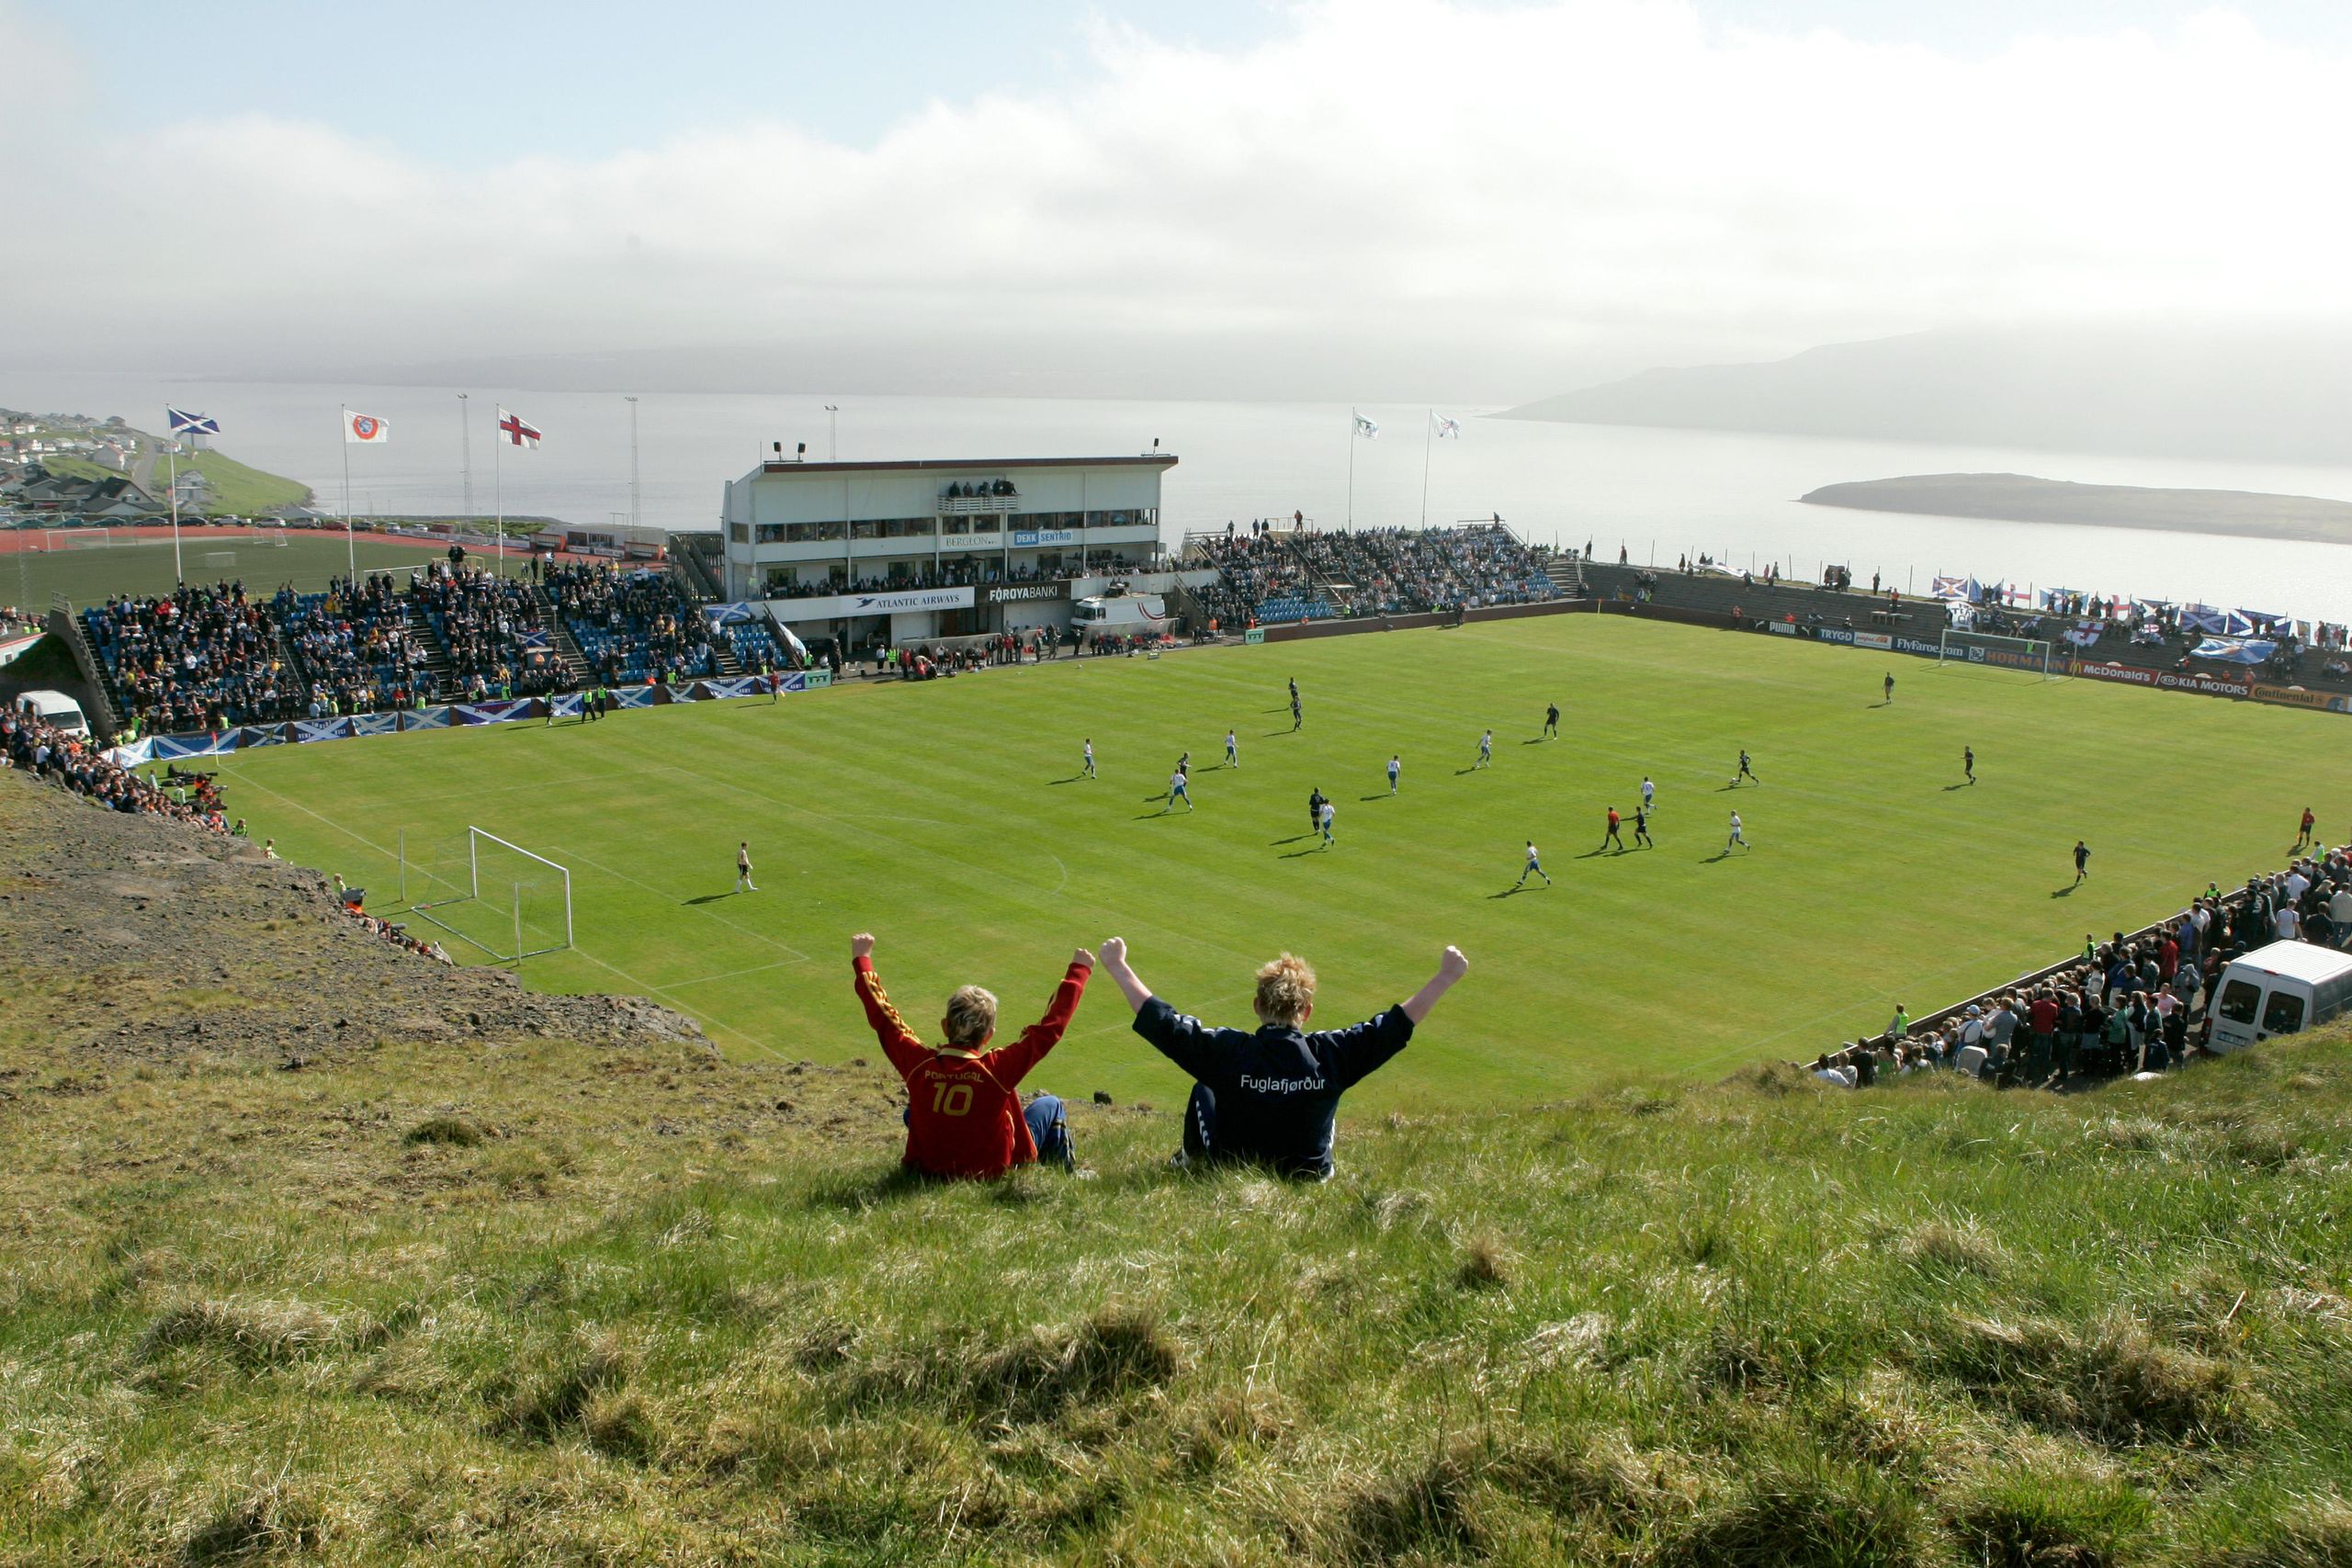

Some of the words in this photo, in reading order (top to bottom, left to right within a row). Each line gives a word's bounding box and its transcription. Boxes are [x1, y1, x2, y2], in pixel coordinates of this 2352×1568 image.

[1016, 535, 1037, 544] DEKK
[876, 597, 918, 607] ATLANTIC
[921, 594, 960, 604] AIRWAYS
[1770, 622, 1796, 635] PUMA
[1821, 628, 1852, 641] TRYGD
[1896, 637, 1963, 657] FlyFaroe.com
[2084, 664, 2151, 682] McDonald's
[2178, 678, 2198, 688] KIA
[2199, 682, 2248, 695] MOTORS
[2255, 687, 2314, 703] Continental
[924, 1070, 984, 1082] PORTUGAL
[1240, 1074, 1325, 1095] Fuglafjørður
[933, 1082, 973, 1116] 10
